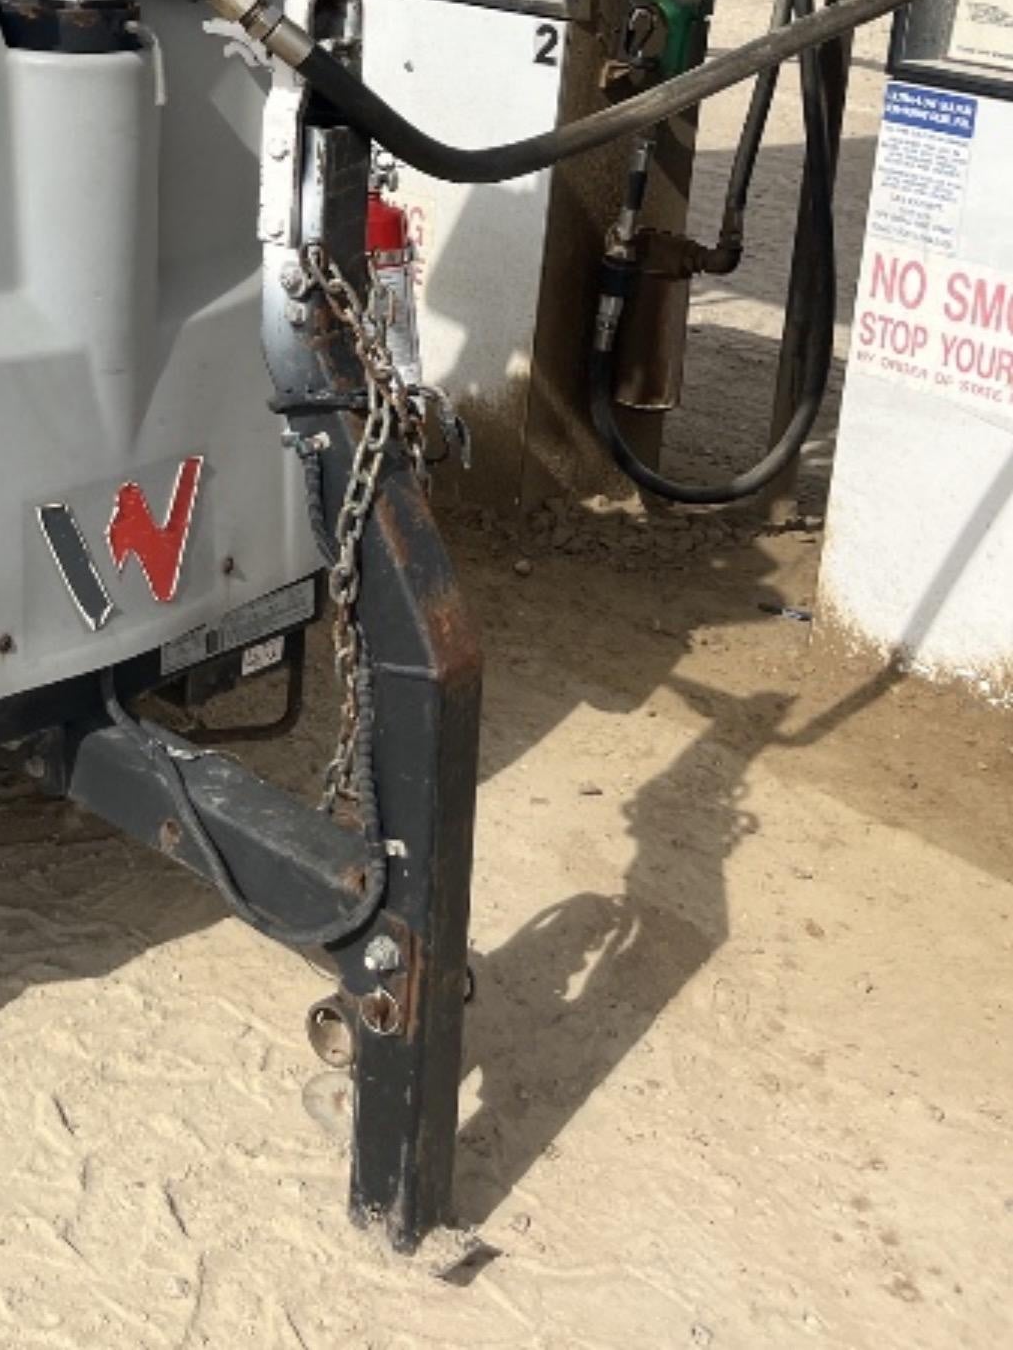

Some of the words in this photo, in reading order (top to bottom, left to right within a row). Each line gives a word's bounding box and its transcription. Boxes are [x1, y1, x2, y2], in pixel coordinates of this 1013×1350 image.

[533, 23, 558, 67] 2
[869, 252, 927, 310] NO
[944, 271, 1013, 338] SM
[859, 311, 929, 358] STOP
[941, 332, 1013, 386] YOUR
